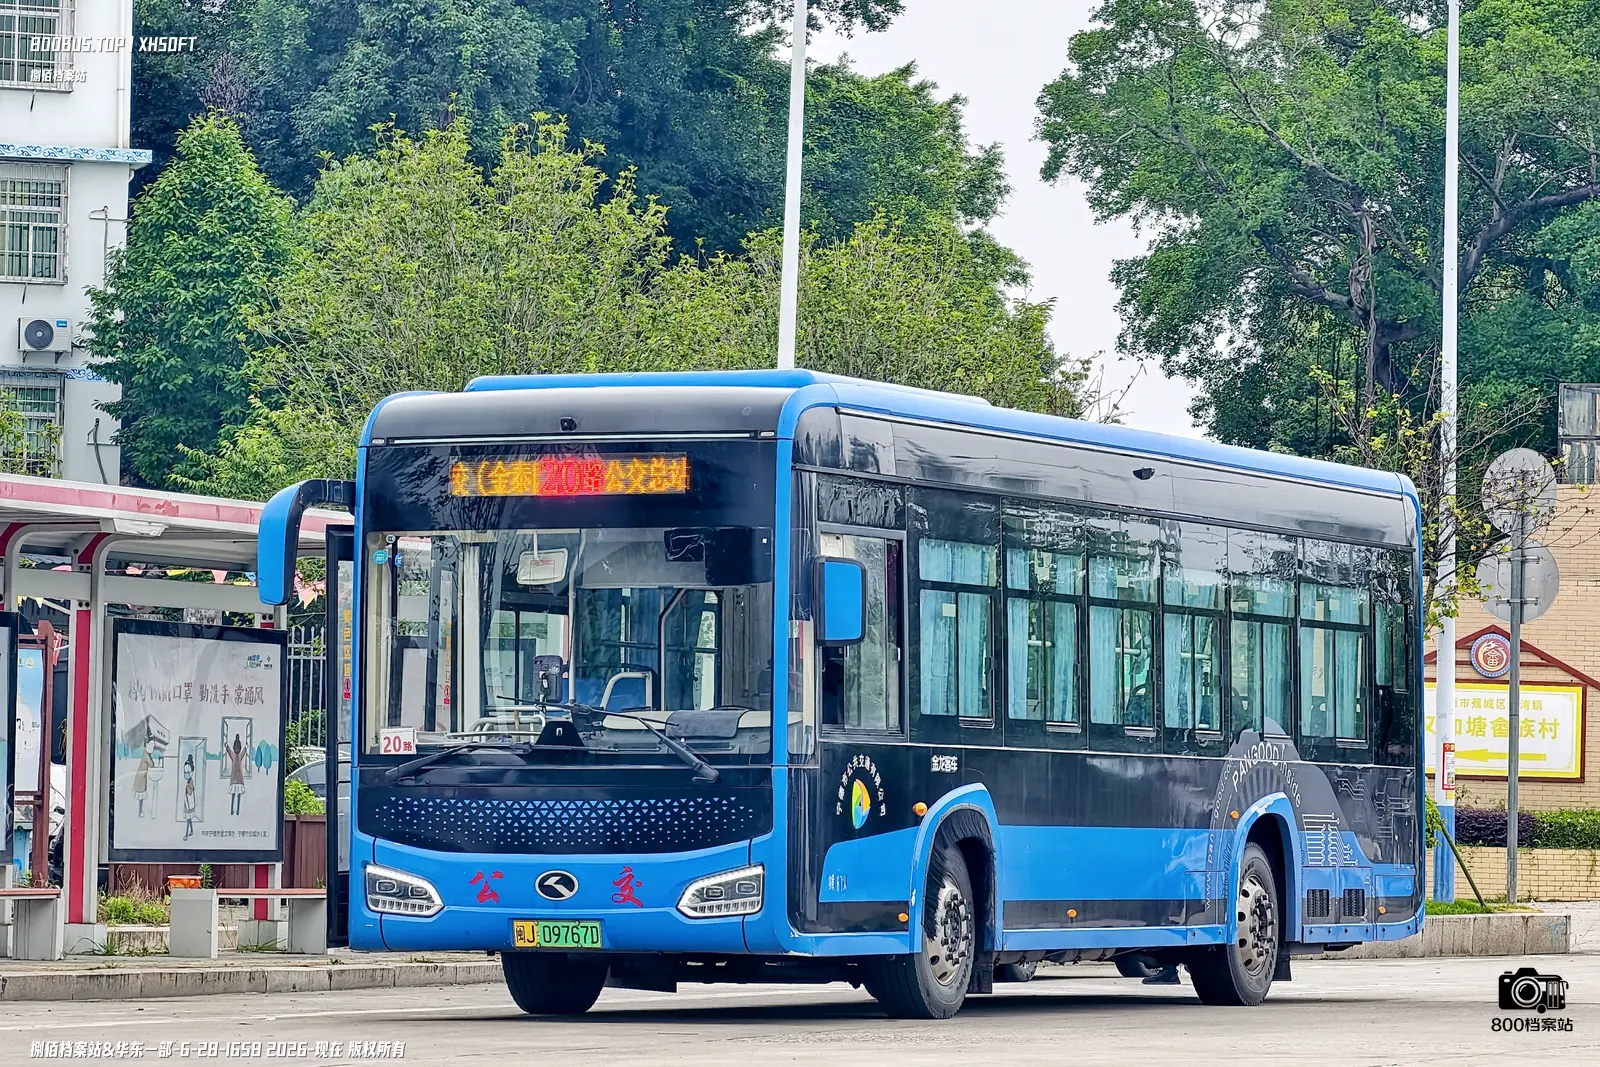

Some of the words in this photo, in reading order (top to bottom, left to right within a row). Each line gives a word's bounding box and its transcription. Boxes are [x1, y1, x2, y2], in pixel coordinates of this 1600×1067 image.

[234, 684, 264, 705] 常通风
[1232, 741, 1279, 792] PANGOOD
[469, 870, 504, 904] 公
[611, 866, 644, 908] 交
